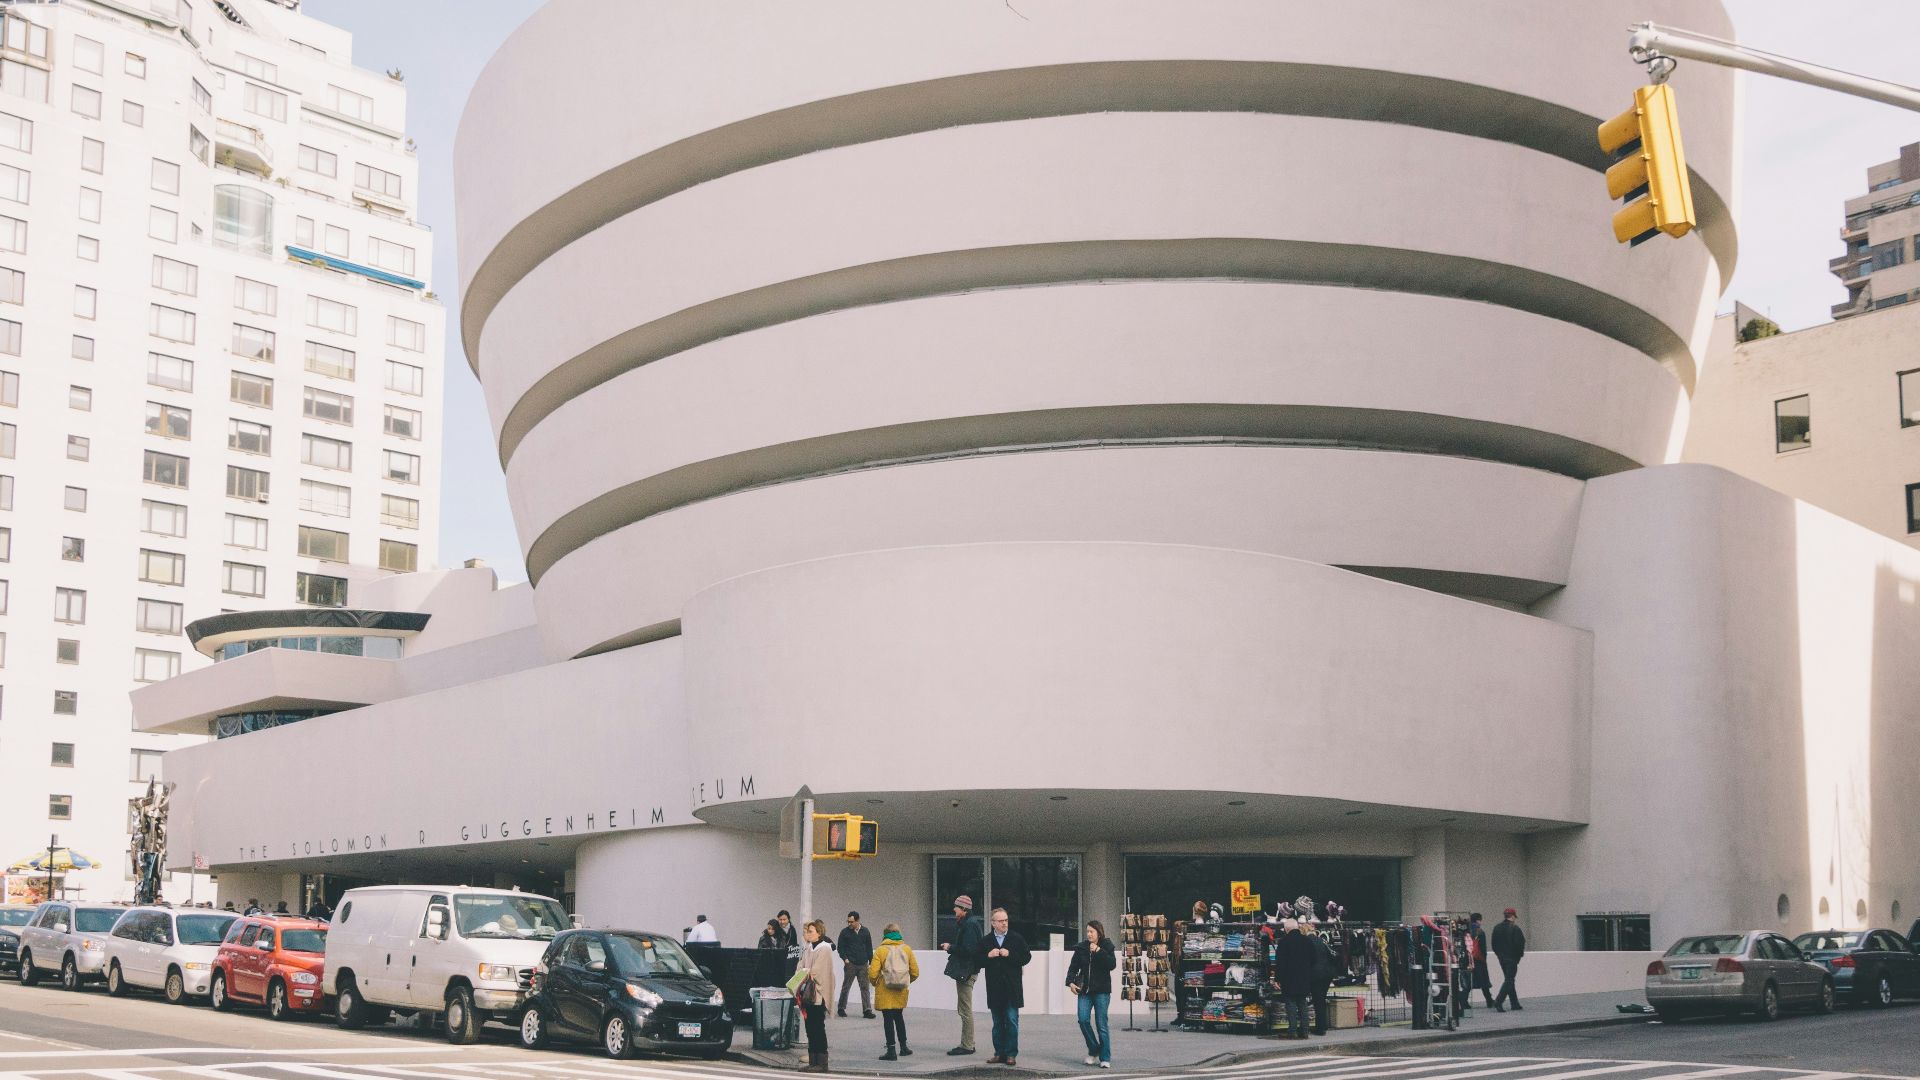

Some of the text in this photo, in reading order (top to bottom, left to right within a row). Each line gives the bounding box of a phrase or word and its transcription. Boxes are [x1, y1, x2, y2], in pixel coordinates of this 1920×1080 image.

[239, 845, 267, 860] THE
[292, 833, 387, 856] SOLOMON
[419, 829, 425, 845] R
[461, 806, 664, 841] GUGGENHEIM
